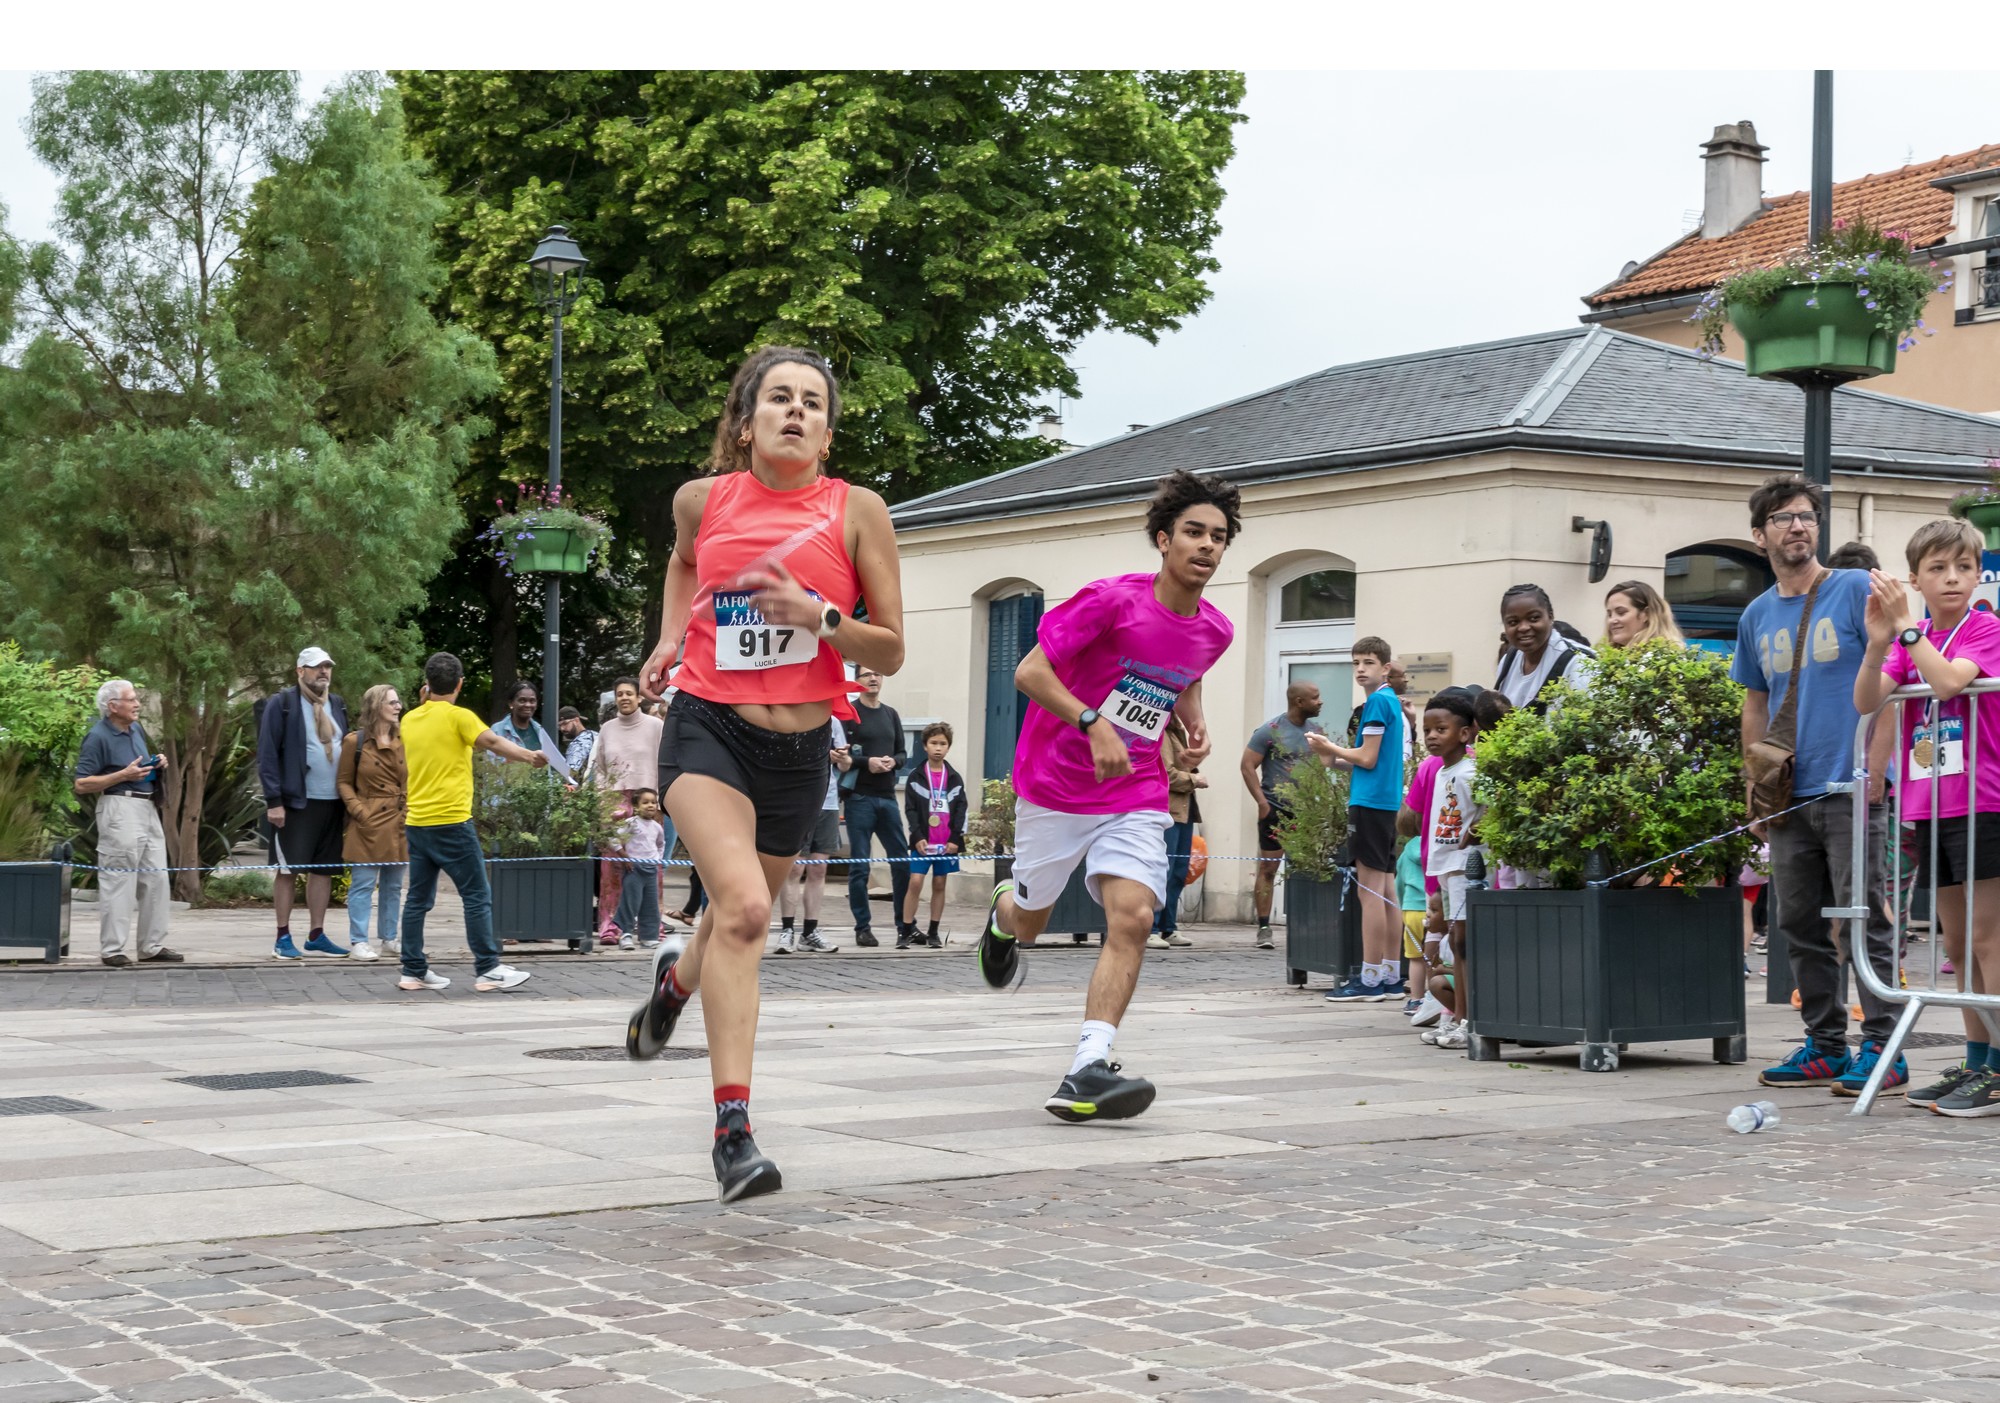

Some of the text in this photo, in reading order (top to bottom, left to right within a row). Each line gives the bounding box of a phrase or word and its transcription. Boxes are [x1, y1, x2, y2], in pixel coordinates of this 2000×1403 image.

[716, 596, 729, 609] LA
[739, 628, 795, 657] 917
[754, 659, 777, 668] LUCILE
[1122, 674, 1135, 683] LA
[1116, 700, 1160, 730] 1045
